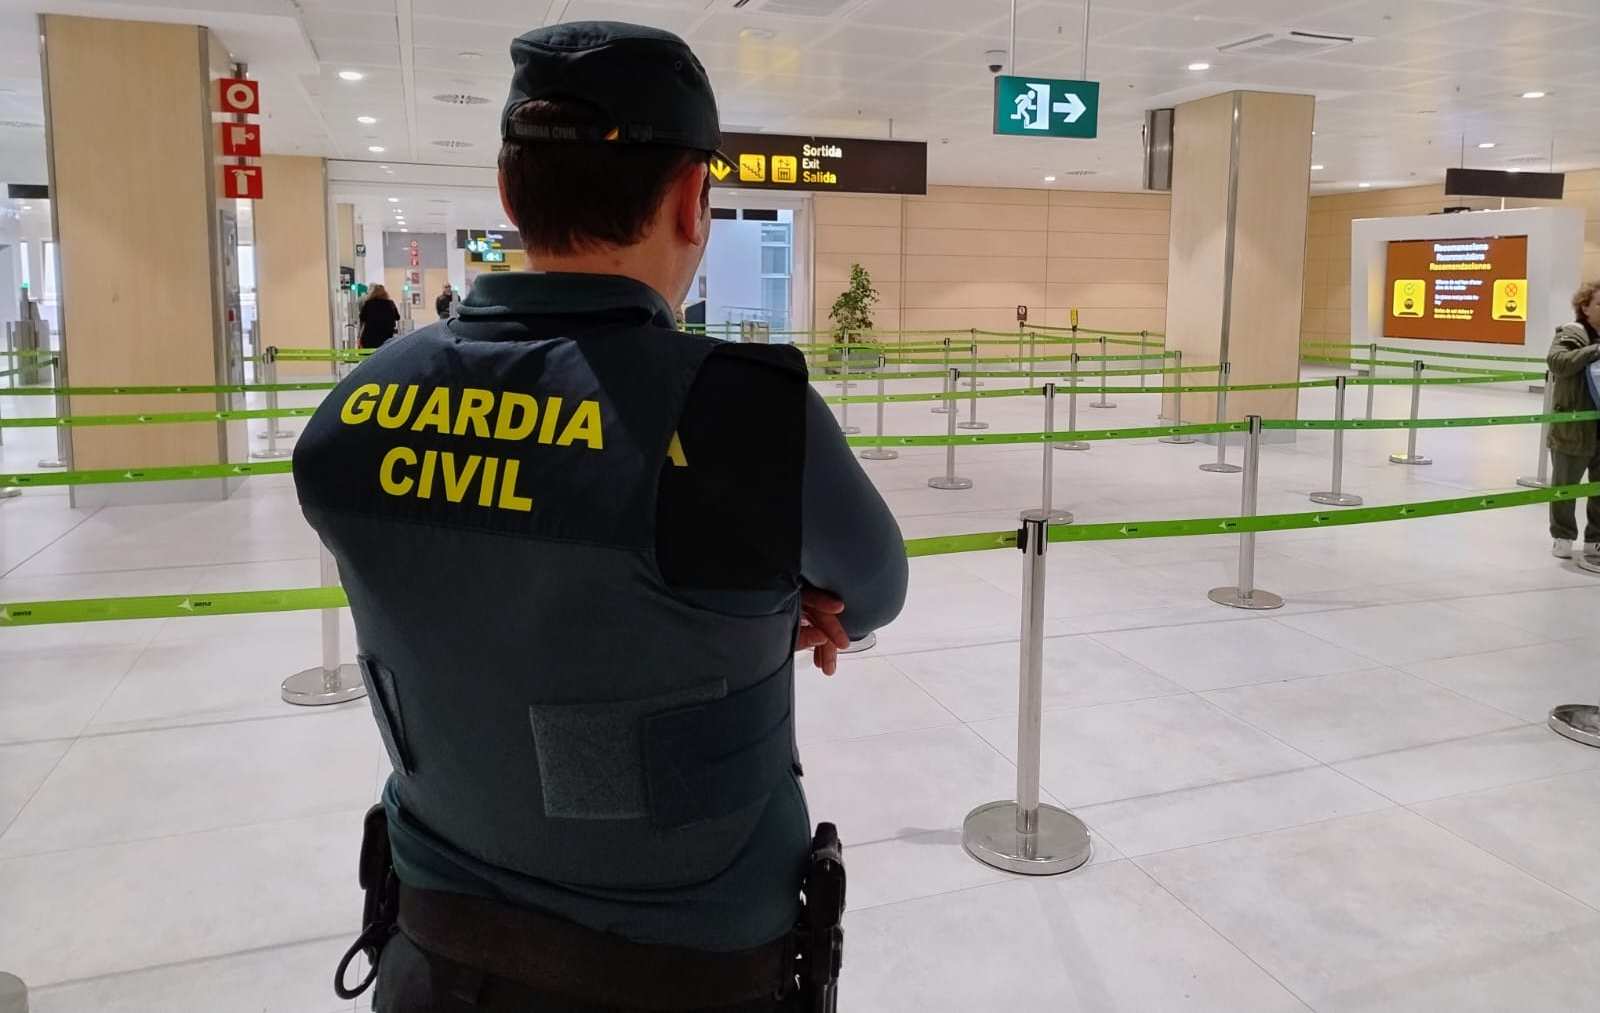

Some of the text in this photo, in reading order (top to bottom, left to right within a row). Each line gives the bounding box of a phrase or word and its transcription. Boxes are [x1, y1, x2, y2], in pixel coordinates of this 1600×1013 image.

[802, 144, 842, 158] Sortida
[802, 158, 820, 170] Exit
[802, 171, 837, 184] Salida
[340, 383, 604, 449] GUARDIA
[379, 447, 533, 512] CIVIL
